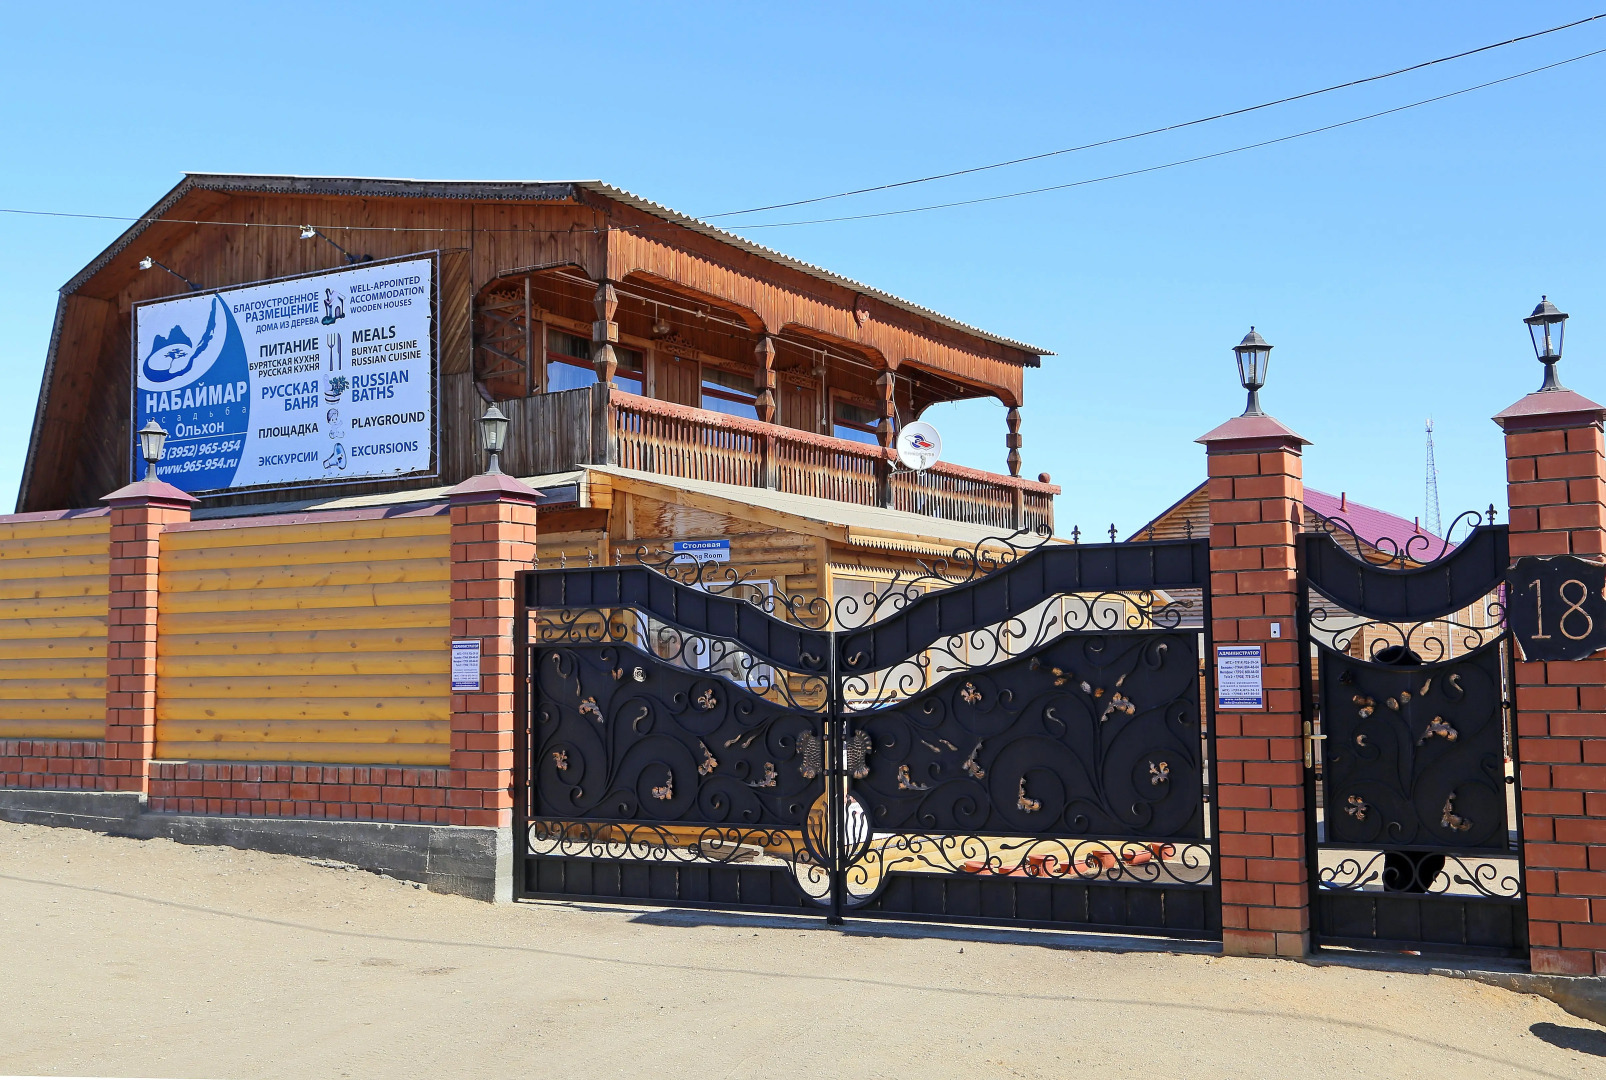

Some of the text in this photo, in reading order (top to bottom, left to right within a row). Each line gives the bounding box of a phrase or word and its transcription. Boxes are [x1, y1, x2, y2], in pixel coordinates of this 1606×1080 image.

[350, 276, 420, 293] WELL-APPOINTED
[234, 292, 319, 314] БЛАГОУСТРОЕННОЕ
[350, 286, 424, 304] ACCOMMODATION
[246, 303, 318, 323] РАЗМЕЩЕНИЕ
[350, 299, 411, 314] WOODEN HOUSES
[256, 316, 319, 334] ДОМА ИЗ ДЕРЕВА
[352, 326, 395, 343] MEALS
[260, 338, 318, 357] ПИТАНИЕ
[352, 340, 417, 356] BURYAT CUISINE
[249, 354, 319, 371] БУРЯТСКАЯ КУХНЯ
[352, 350, 421, 366] RUSSIAN CUISINE
[259, 363, 319, 378] РУССКАЯ КУХНЯ
[352, 370, 408, 388] RUSSIAN
[146, 382, 248, 414] НАБАЙМАР
[262, 380, 318, 399] РУССКАЯ
[352, 386, 394, 402] BATHS
[285, 395, 318, 411] БАНЯ
[352, 412, 425, 428] PLAYGROUND
[176, 422, 224, 437] Ольхон
[259, 423, 318, 439] ПЛОЩАДКА
[167, 444, 198, 460] (3952)
[199, 440, 241, 455] 965-954
[352, 441, 418, 457] EXCURSIONS
[157, 457, 237, 475] www.965-954.ru
[259, 451, 318, 466] ЭКСКУРСИИ
[1529, 579, 1593, 640] 18
